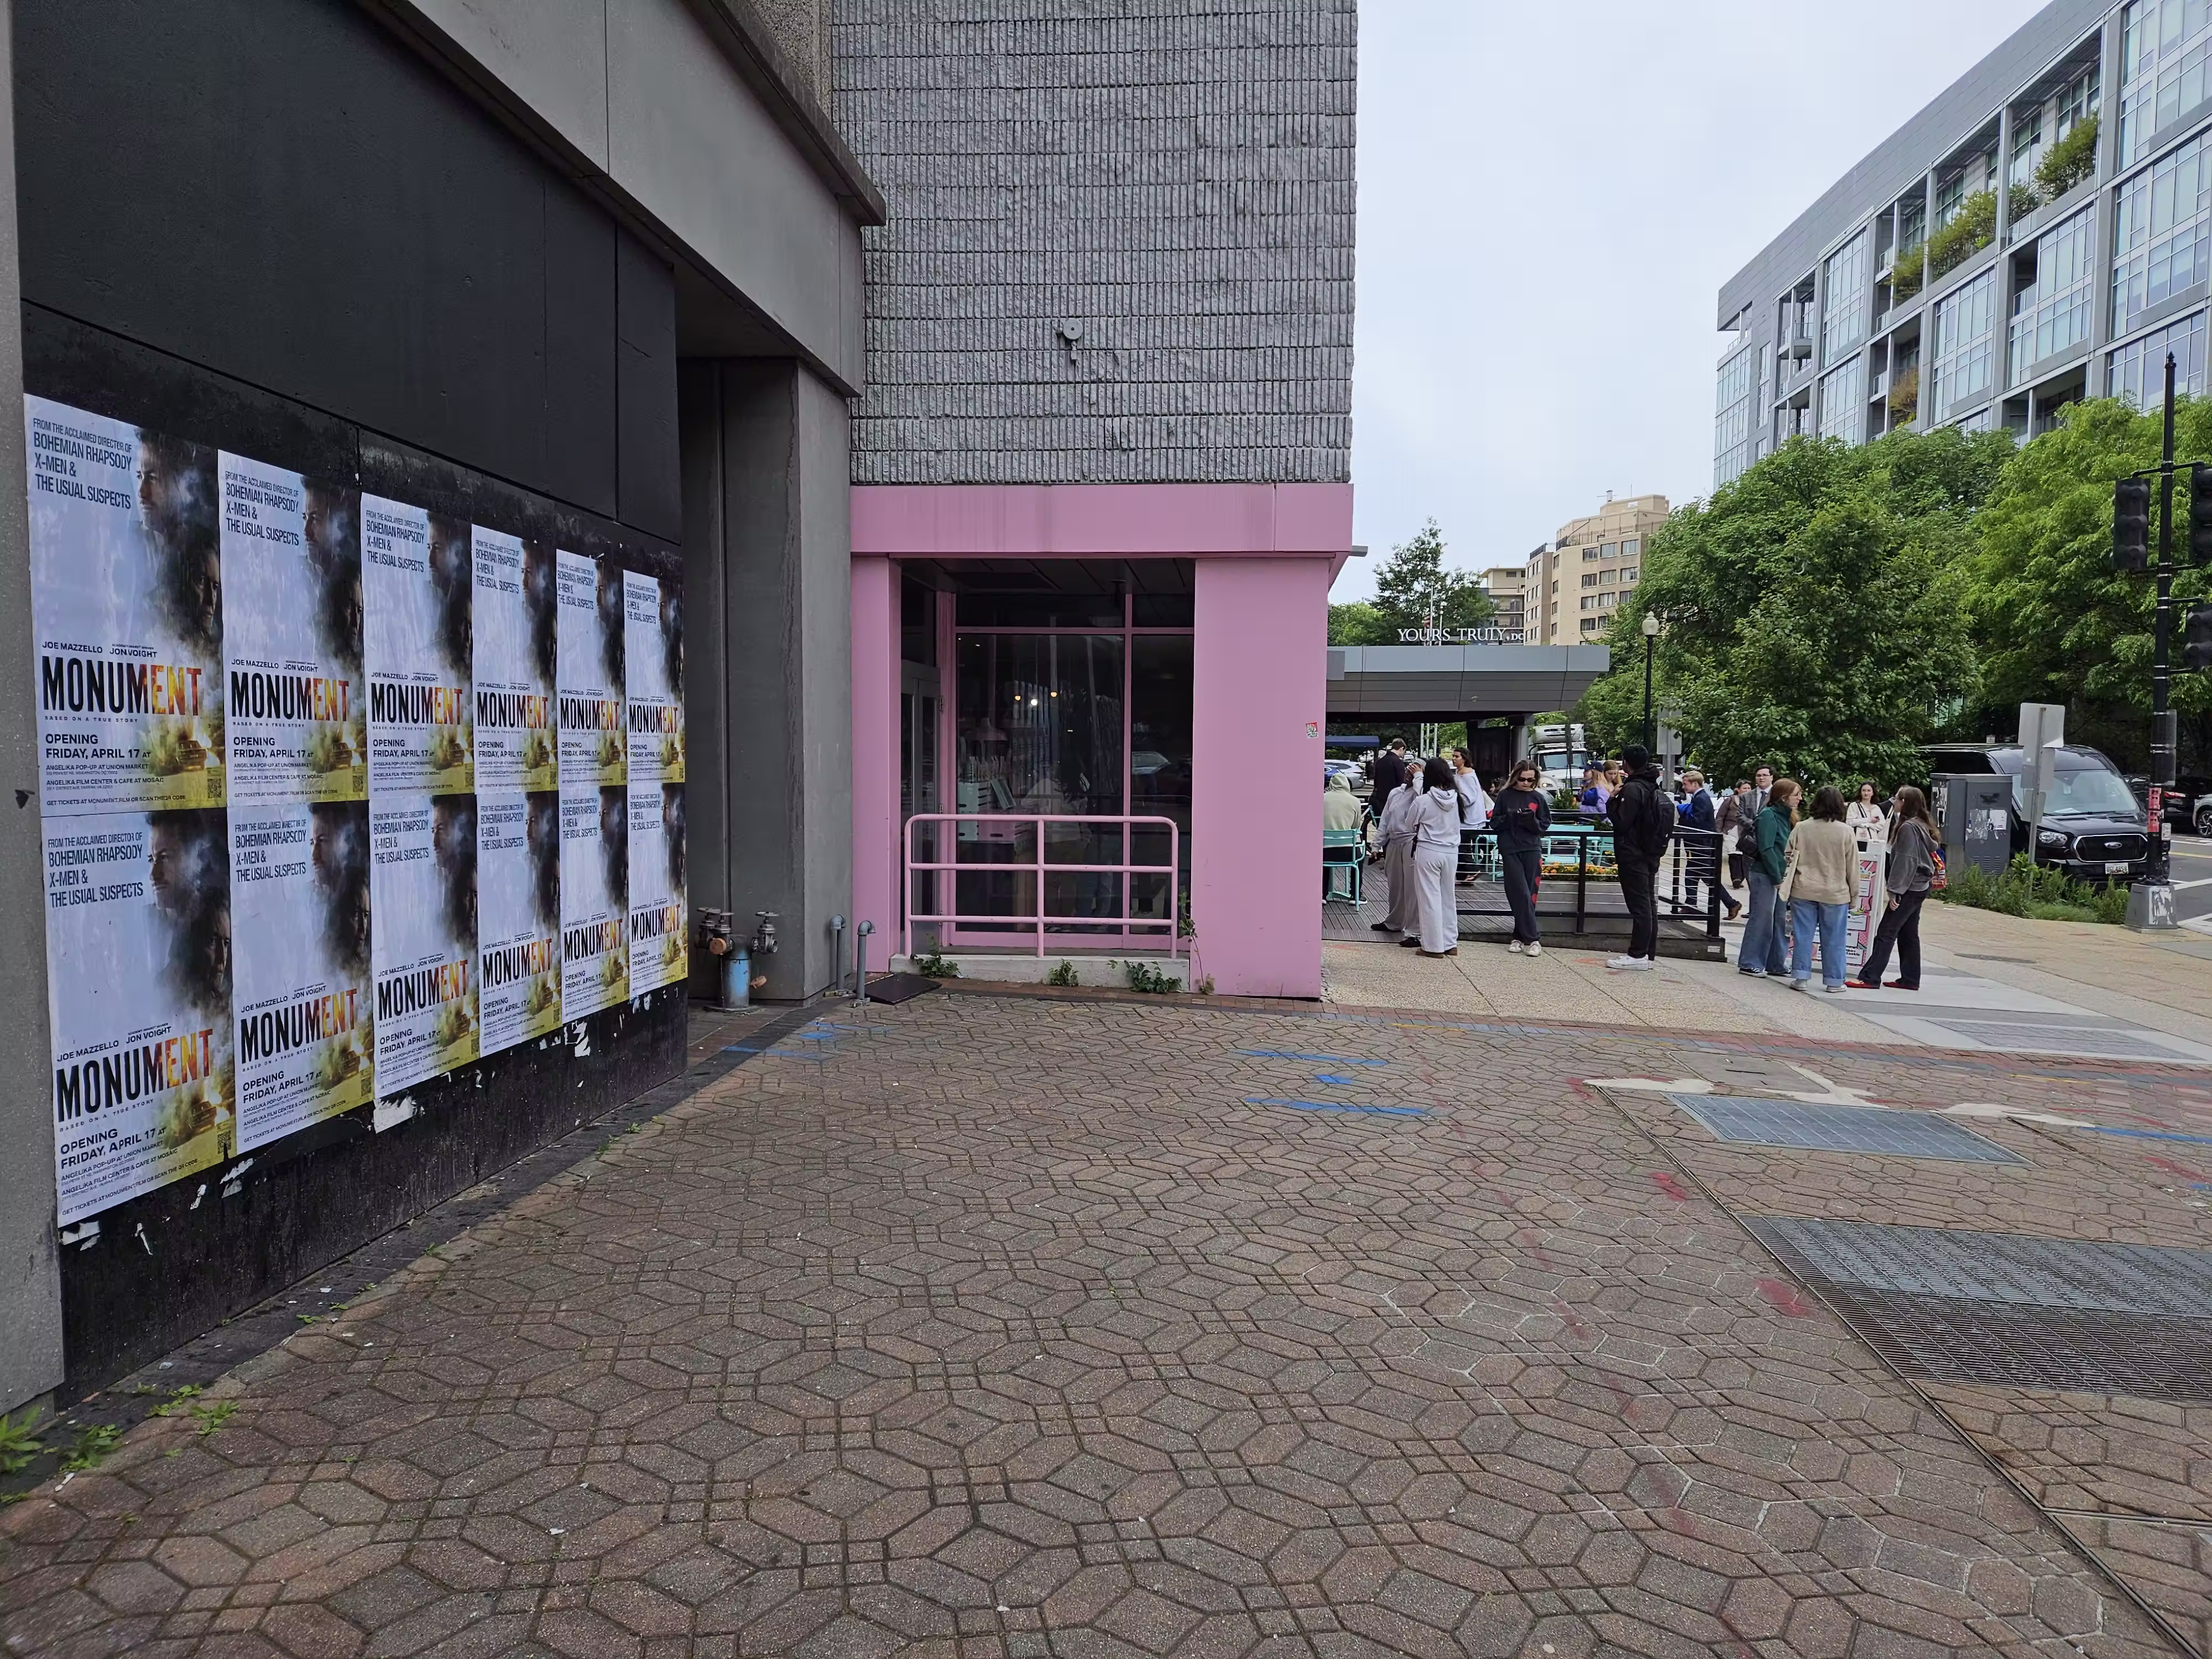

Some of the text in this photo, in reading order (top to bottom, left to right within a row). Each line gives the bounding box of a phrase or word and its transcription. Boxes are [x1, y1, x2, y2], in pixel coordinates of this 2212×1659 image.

[33, 418, 132, 453] FROM THE ACCLAIMED DIRECTOR OF
[33, 431, 132, 471] BOHEMIAN RHAPSODY
[34, 452, 76, 477] X-MEN &
[35, 473, 131, 510] THE USUAL SUSPECTS
[225, 482, 299, 513] BOHEMIAN RHAPSODY
[226, 499, 257, 520] X-MEN &
[226, 518, 299, 546] THE USUAL SUSPECTS
[366, 520, 424, 544] BOHEMIAN RHAPSODY
[1397, 628, 1524, 641] YOURS TRULY, DC
[41, 640, 59, 650] JOE
[60, 642, 102, 653] MAZZELLO
[109, 646, 127, 655] JON
[128, 649, 158, 658] VOIGHT
[42, 656, 201, 716] MONUMENT
[231, 671, 349, 722] MONUMENT
[371, 683, 462, 724] MONUMENT
[477, 691, 548, 729] MONUMENT
[560, 698, 619, 731] MONUMENT
[629, 705, 677, 733] MONUMENT
[45, 734, 98, 744] OPENING
[234, 737, 275, 746] OPENING
[46, 748, 88, 760] FRIDAY,
[91, 749, 124, 758] APRIL
[128, 749, 140, 758] 17
[234, 749, 267, 759] FRIDAY,
[269, 749, 295, 758] APRIL
[373, 750, 399, 758] FRIDAY,
[47, 831, 142, 848] FROM THE ACCLAIMED DIRECTOR OF
[235, 829, 306, 849] BOHEMIAN RHAPSODY
[373, 819, 429, 835] BOHEMIAN RHAPSODY
[47, 843, 143, 868] BOHEMIAN RHAPSODY
[236, 850, 266, 865] X-MEN &
[48, 869, 88, 888] X-MEN &
[236, 861, 306, 883] THE USUAL SUSPECTS
[49, 881, 143, 908] THE USUAL SUSPECTS
[631, 905, 680, 942] MONUMENT
[564, 919, 623, 962] MONUMENT
[483, 938, 552, 989] MONUMENT
[633, 950, 648, 960] OPENING
[566, 970, 585, 982] OPENING
[582, 975, 594, 984] APRIL
[378, 960, 467, 1021] MONUMENT
[484, 997, 508, 1010] OPENING
[504, 1001, 519, 1013] APRIL
[241, 989, 357, 1063] MONUMENT
[380, 1028, 411, 1045] OPENING
[57, 1051, 75, 1062] JOE
[75, 1039, 118, 1058] MAZZELLO
[125, 1032, 142, 1044] JON
[143, 1025, 172, 1040] VOIGHT
[380, 1030, 435, 1057] FRIDAY, APRIL 17
[56, 1028, 213, 1122] MONUMENT
[243, 1070, 284, 1092] OPENING
[244, 1084, 276, 1105] FRIDAY,
[278, 1075, 303, 1092] APRIL
[305, 1071, 314, 1082] 17
[61, 1128, 117, 1155] OPENING
[61, 1127, 166, 1170] FRIDAY, APRIL 17 AT
[61, 1180, 92, 1197] ANGELIKA
[93, 1175, 107, 1185] FILM
[108, 1166, 129, 1179] CENTER
[135, 1159, 149, 1168] CAFE
[158, 1148, 177, 1160] MOSAIC
